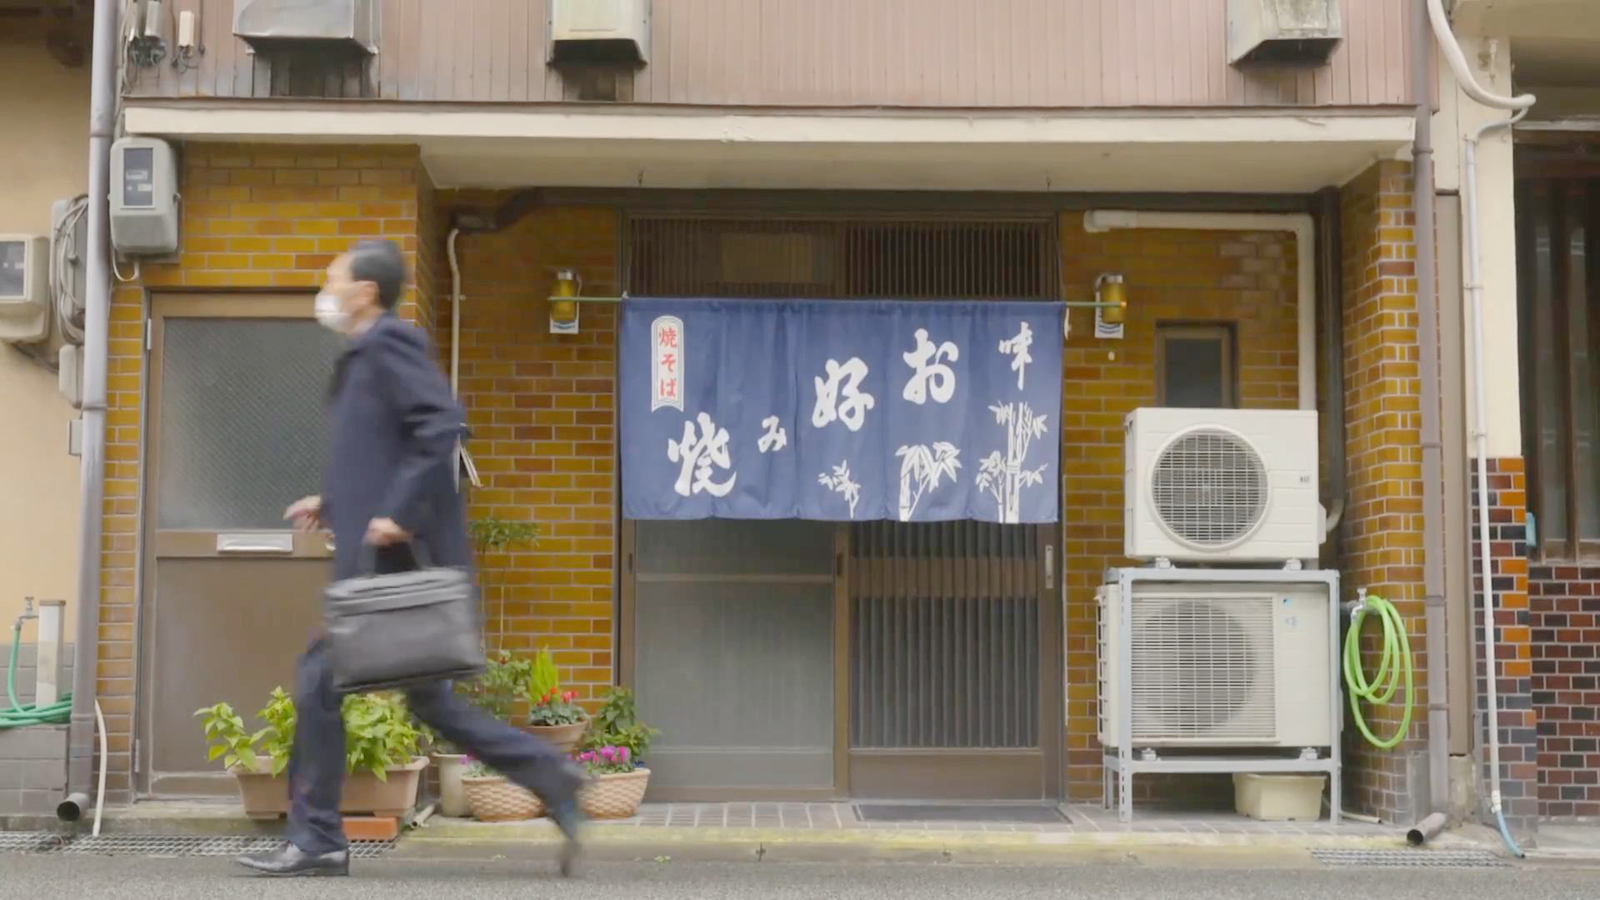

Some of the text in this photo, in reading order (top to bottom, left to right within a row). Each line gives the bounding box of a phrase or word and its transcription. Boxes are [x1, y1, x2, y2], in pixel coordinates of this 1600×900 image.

[658, 326, 678, 398] 焼そば
[998, 321, 1033, 392] 味
